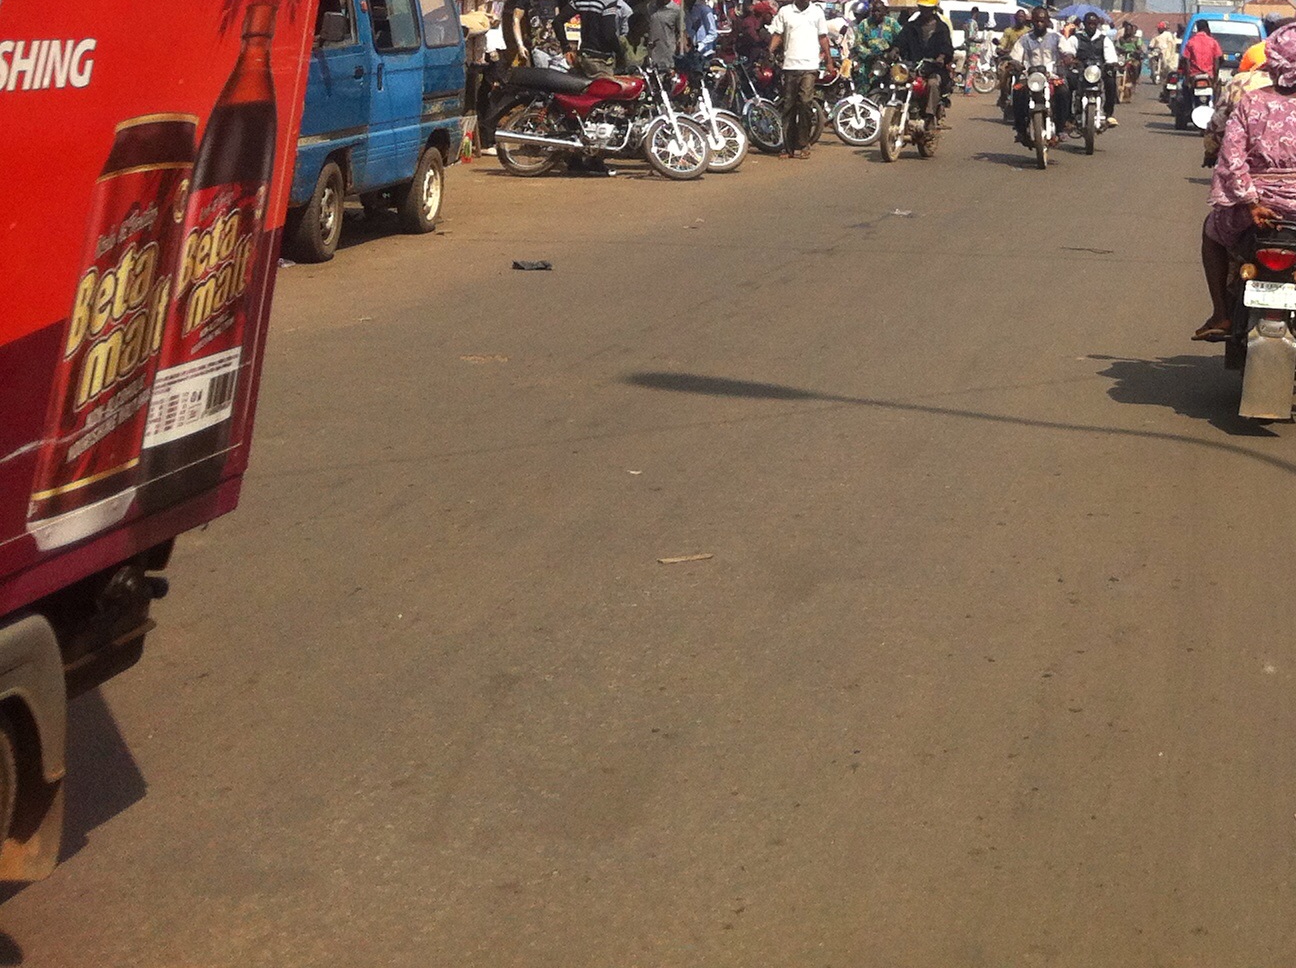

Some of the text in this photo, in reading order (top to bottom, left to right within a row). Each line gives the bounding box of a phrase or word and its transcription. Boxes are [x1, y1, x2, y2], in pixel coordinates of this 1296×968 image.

[63, 240, 161, 363] Beta
[175, 207, 242, 302] Beta
[182, 233, 253, 339] malt
[73, 272, 173, 414] malt
